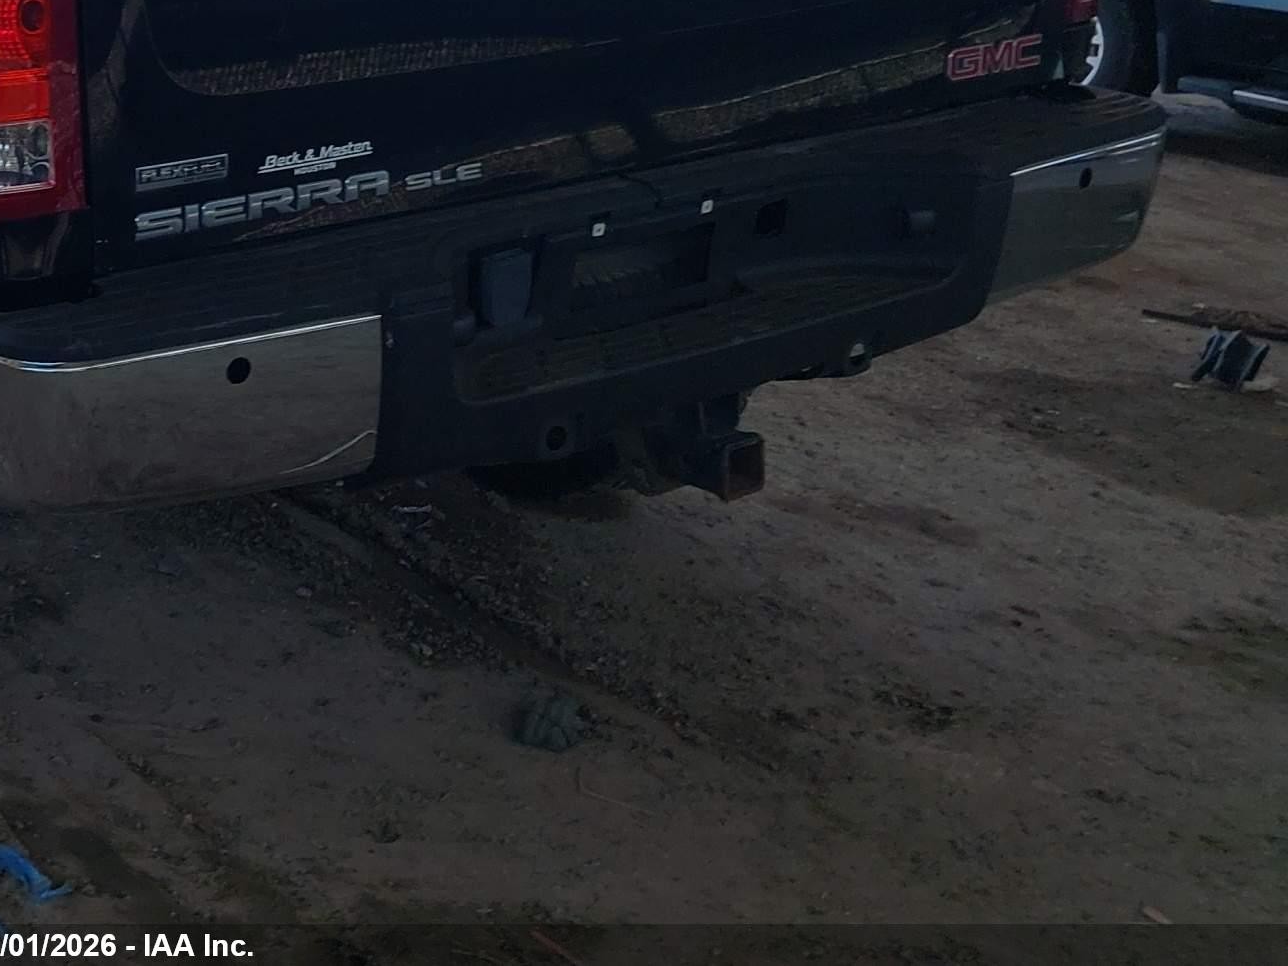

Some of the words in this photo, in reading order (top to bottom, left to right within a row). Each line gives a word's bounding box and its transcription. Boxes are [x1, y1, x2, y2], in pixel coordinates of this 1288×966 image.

[947, 34, 1043, 80] GMC
[265, 151, 300, 167] Beck
[304, 148, 314, 161] &
[135, 170, 390, 242] SIERRA
[405, 163, 483, 192] SLE
